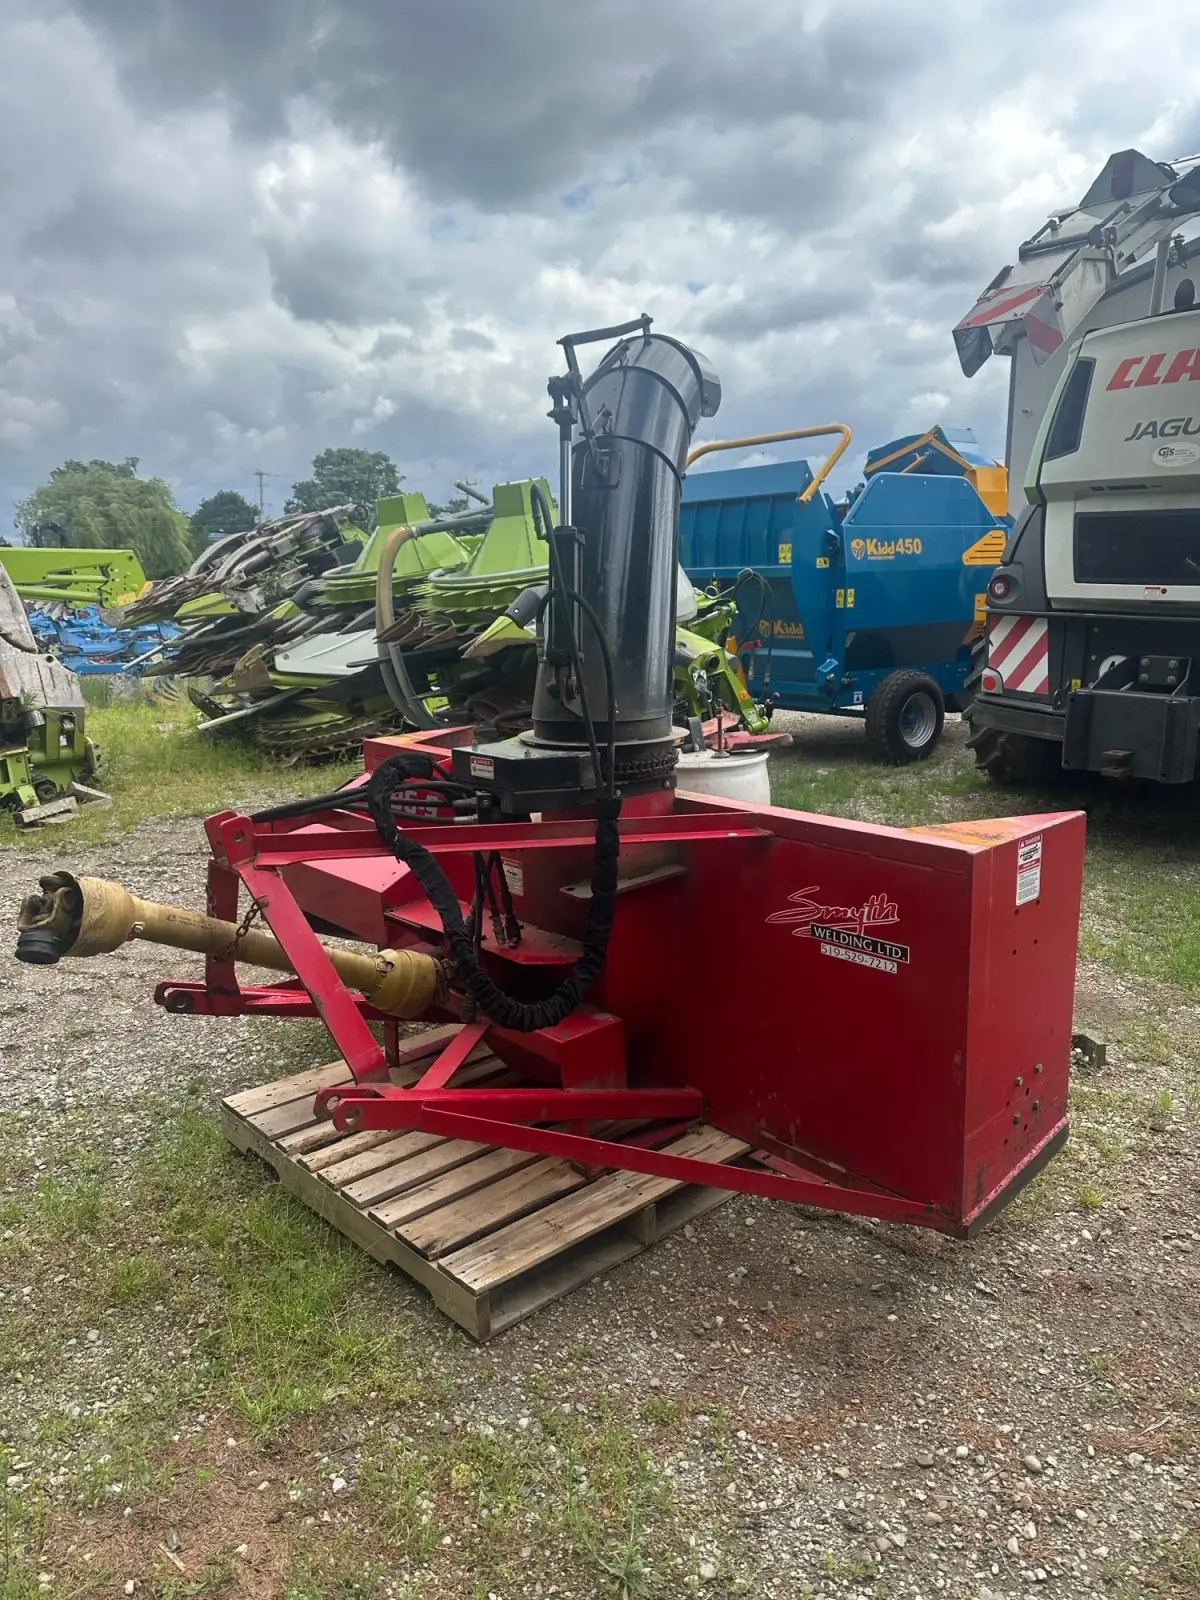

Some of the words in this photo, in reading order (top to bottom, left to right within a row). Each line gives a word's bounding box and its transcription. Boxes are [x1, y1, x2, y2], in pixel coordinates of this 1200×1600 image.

[866, 538, 895, 556] Kidd
[896, 538, 922, 555] 450
[773, 620, 804, 635] Kidd
[765, 886, 900, 937] Smyth
[813, 925, 873, 952] WELDING
[877, 942, 906, 961] LTD.
[821, 945, 897, 973] 519-529-7212
